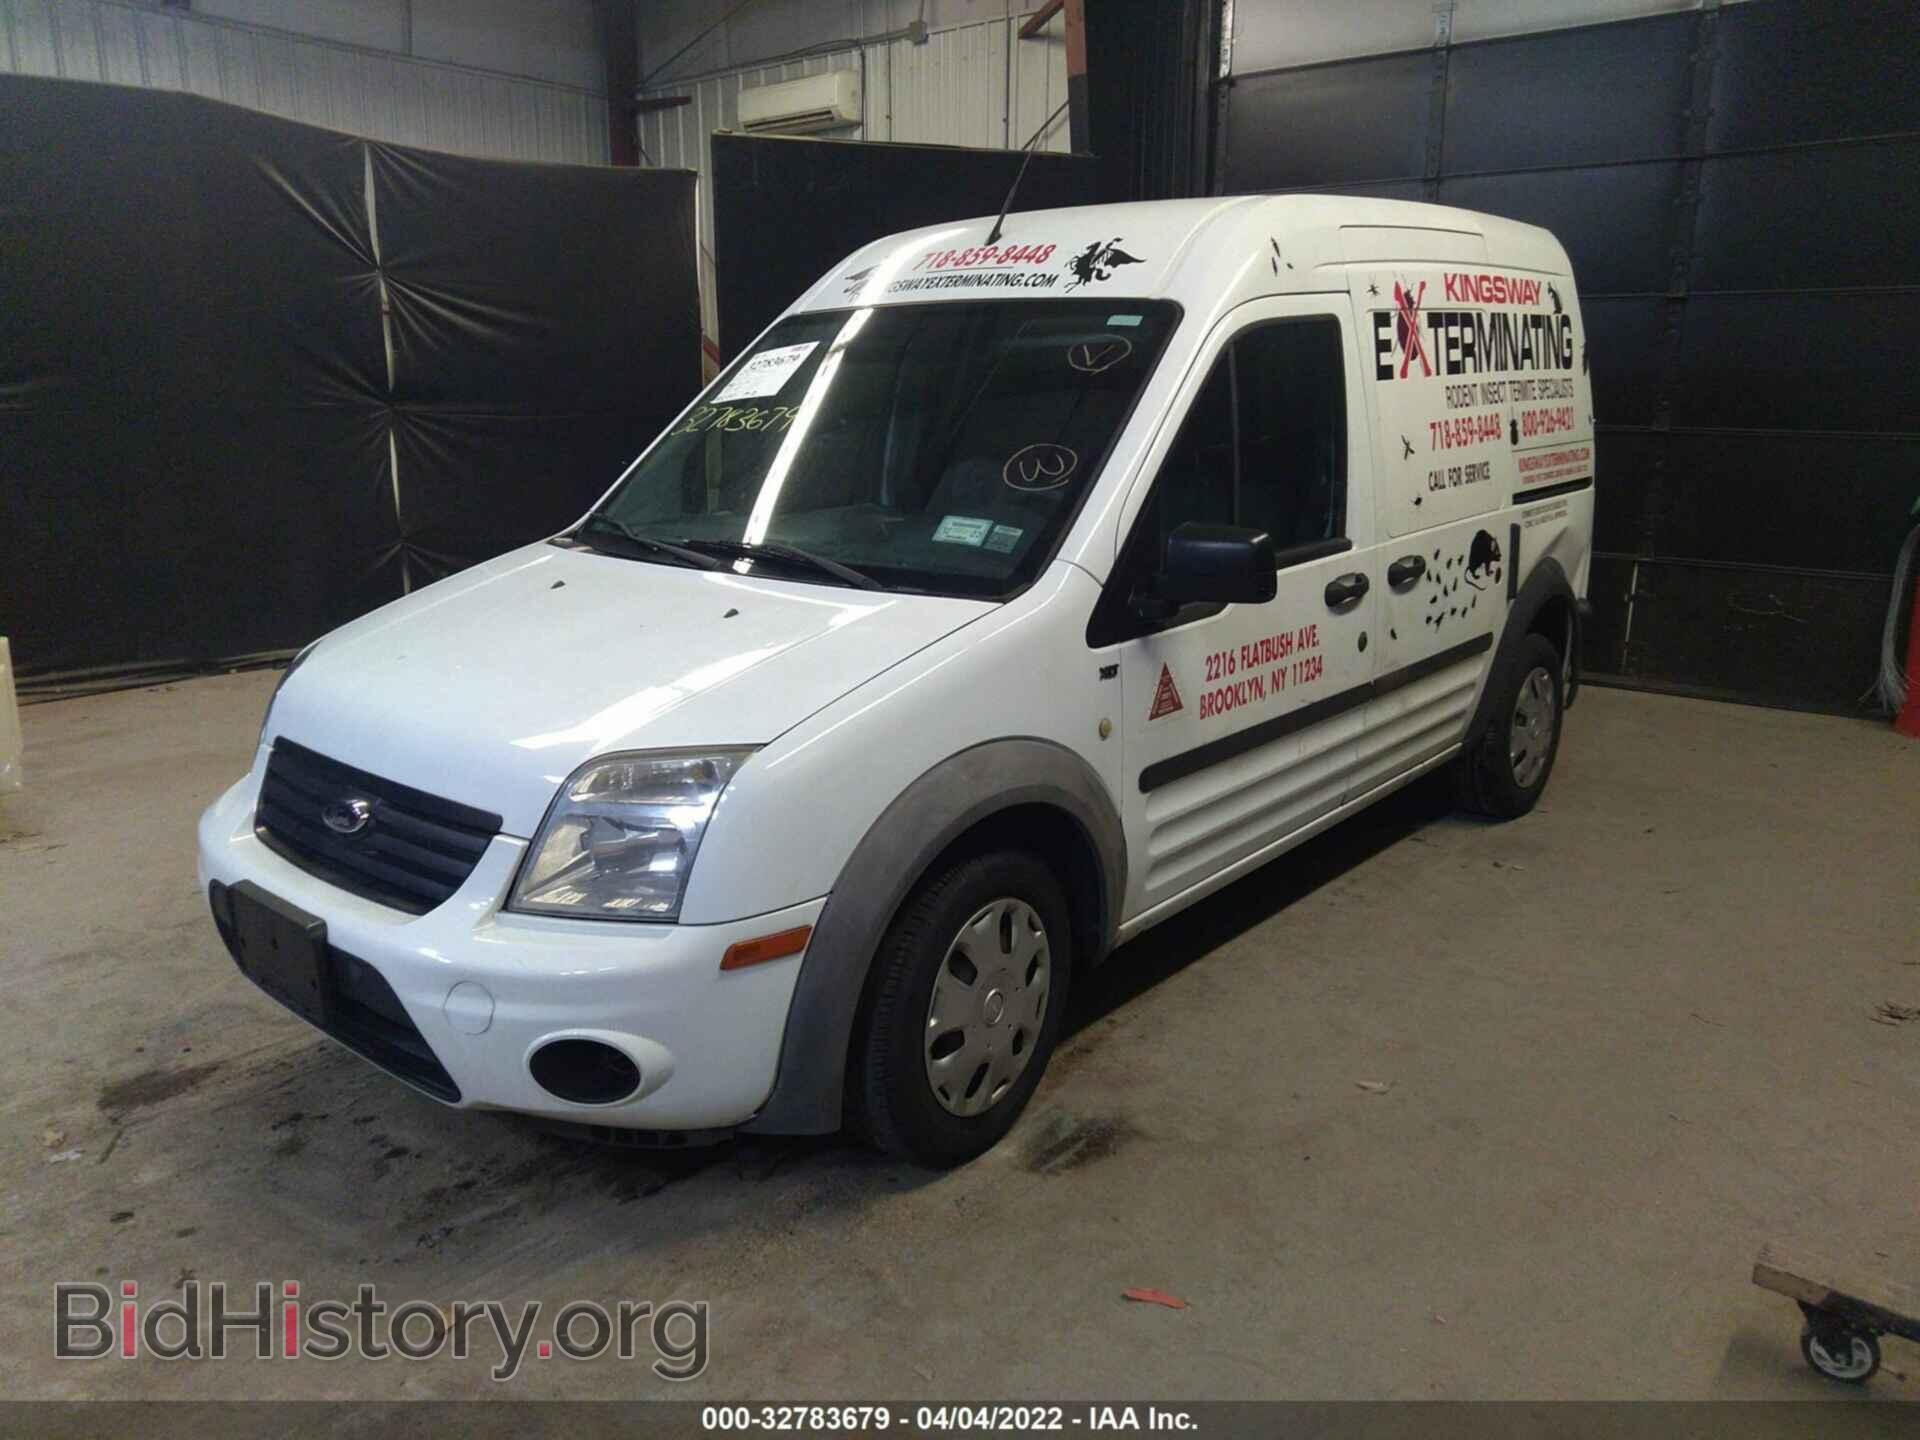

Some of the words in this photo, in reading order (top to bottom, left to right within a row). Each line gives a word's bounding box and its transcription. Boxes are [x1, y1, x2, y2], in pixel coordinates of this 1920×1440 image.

[913, 243, 1057, 271] 718-859-8448
[1444, 273, 1541, 305] KINGSWAY
[1373, 281, 1573, 381] EXTERMINATING
[1446, 383, 1477, 409] RODENT
[1429, 413, 1502, 452] 718-859-8448
[1428, 469, 1446, 492] CALL
[1448, 466, 1462, 489] FOR
[1464, 461, 1490, 485] SERVICE
[1205, 650, 1236, 683] 2216
[1240, 631, 1294, 671] FLATBUSH
[1297, 624, 1320, 650] AVE.
[1200, 674, 1267, 720] BROOKLYN,
[1271, 666, 1289, 694] NY
[1293, 655, 1323, 685] 11234
